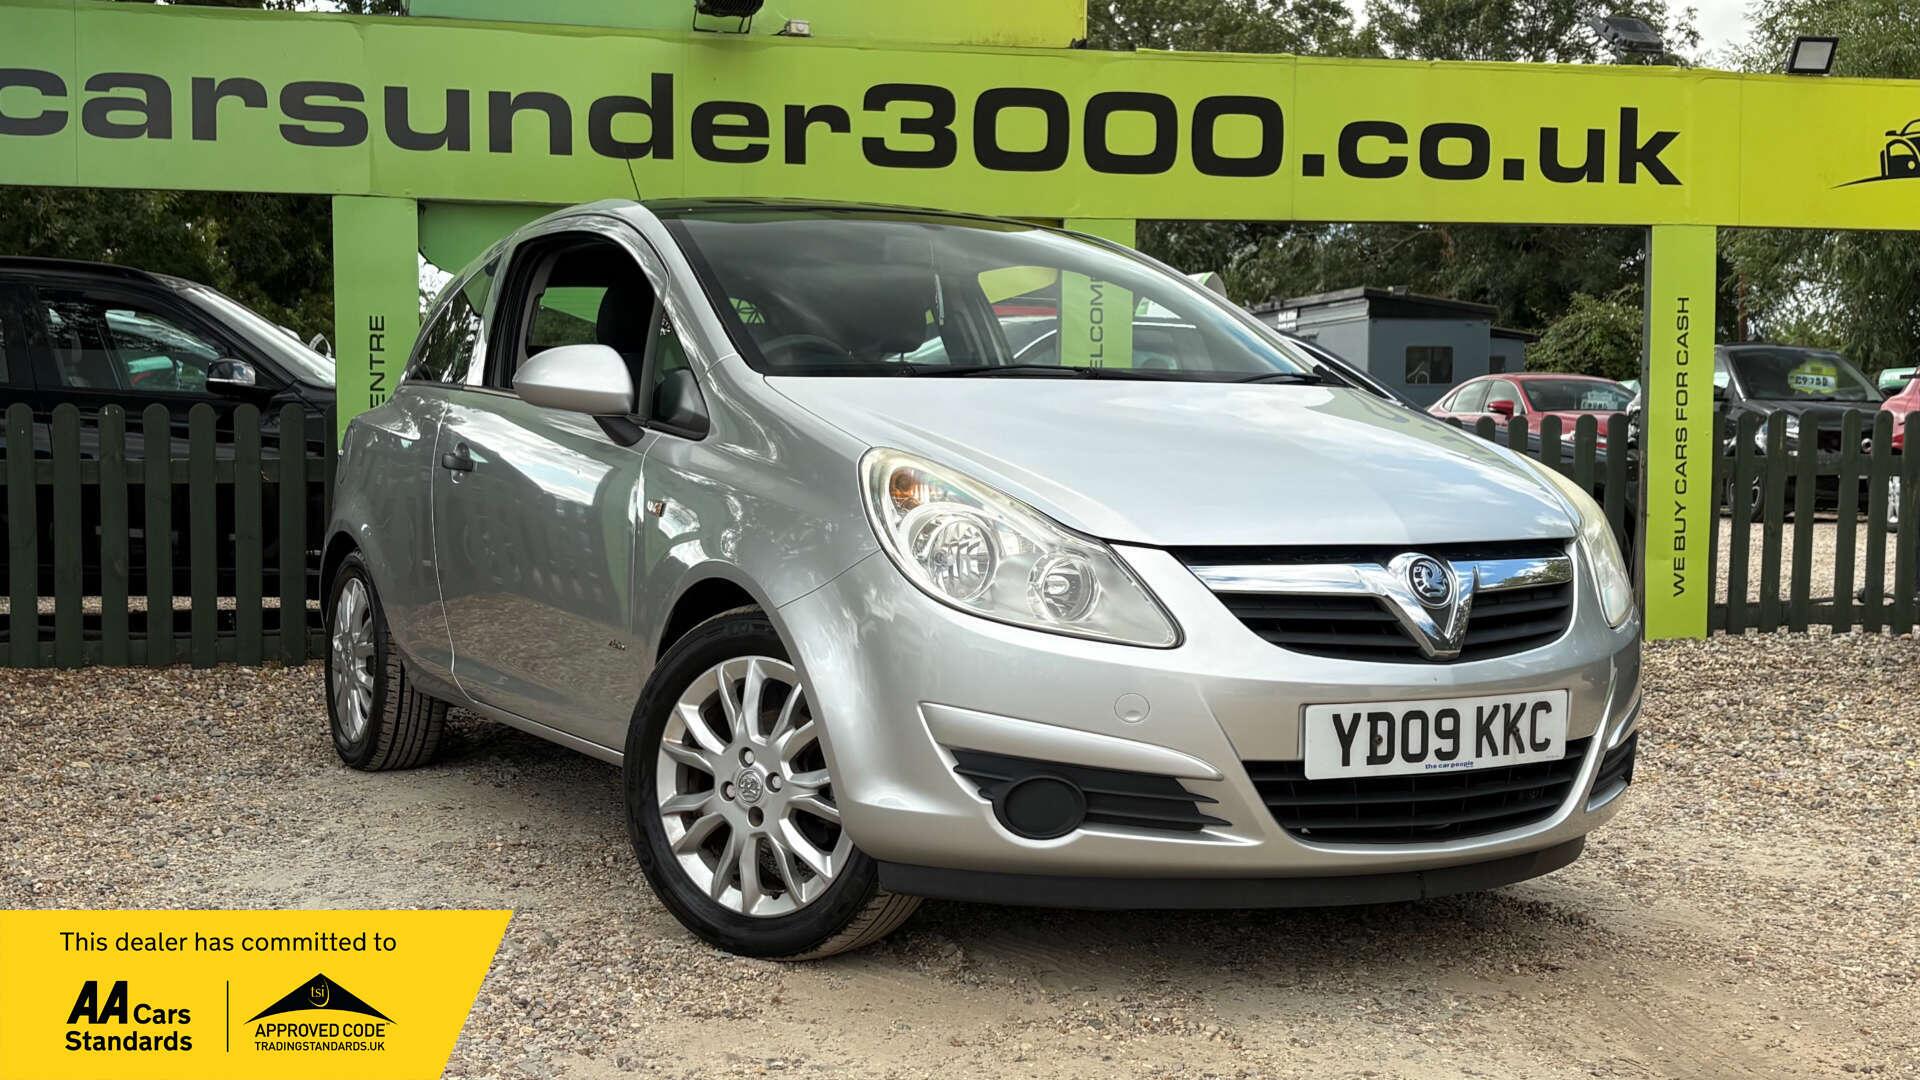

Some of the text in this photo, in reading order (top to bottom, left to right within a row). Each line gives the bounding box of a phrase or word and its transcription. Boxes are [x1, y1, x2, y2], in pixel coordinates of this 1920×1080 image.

[0, 69, 1683, 186] carsunder3000.co.uk
[1673, 297, 1690, 598] WE BUY CARS FOR CASH
[1332, 700, 1552, 767] YD09 KKC
